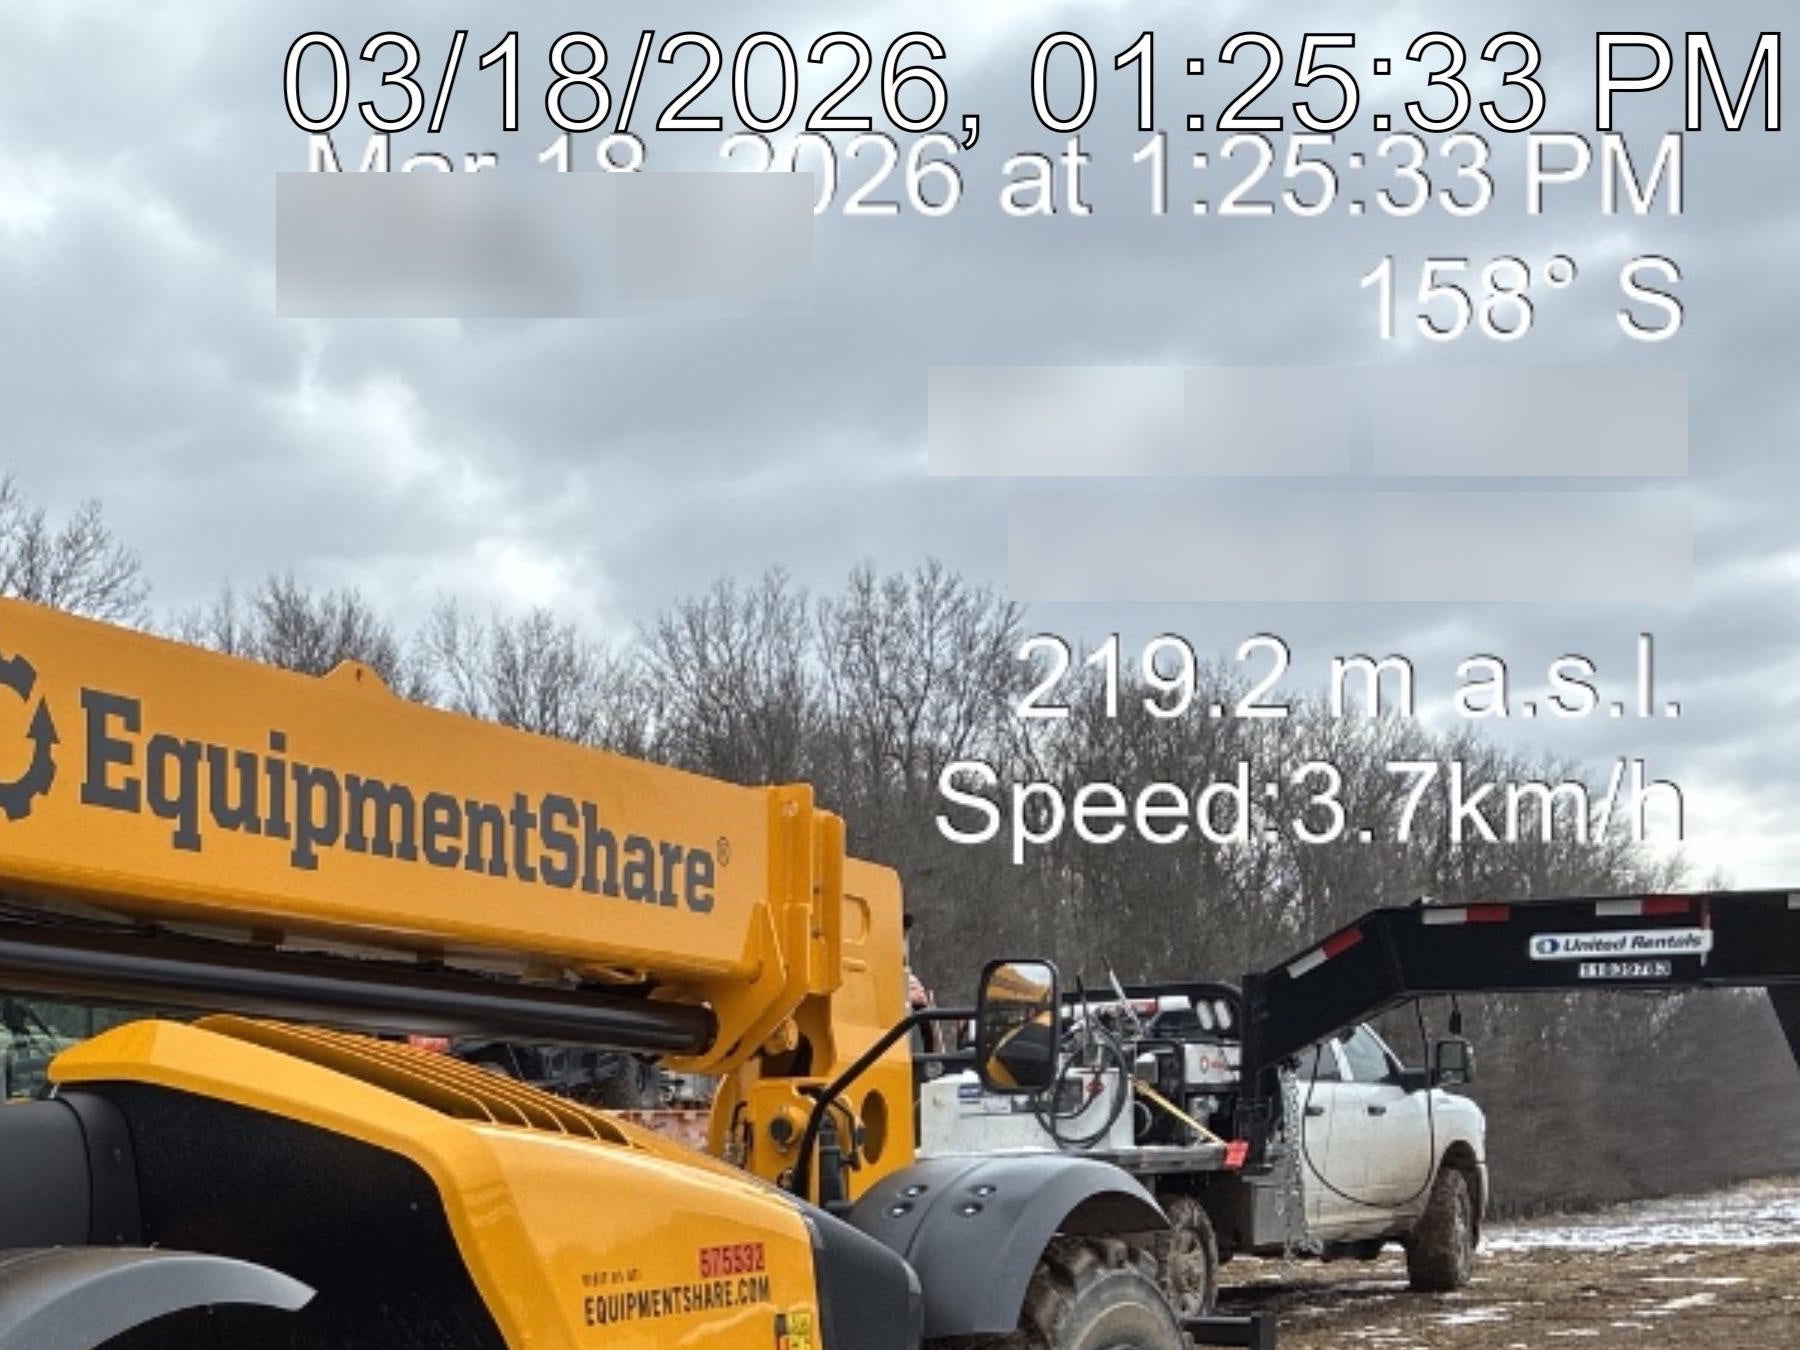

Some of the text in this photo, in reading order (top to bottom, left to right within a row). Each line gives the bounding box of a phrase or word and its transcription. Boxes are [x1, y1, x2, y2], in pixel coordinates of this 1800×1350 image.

[1564, 932, 1702, 952] United Rentals
[699, 1243, 765, 1278] 575532
[584, 1276, 771, 1327] EQUIPMENTSHARE.COM
